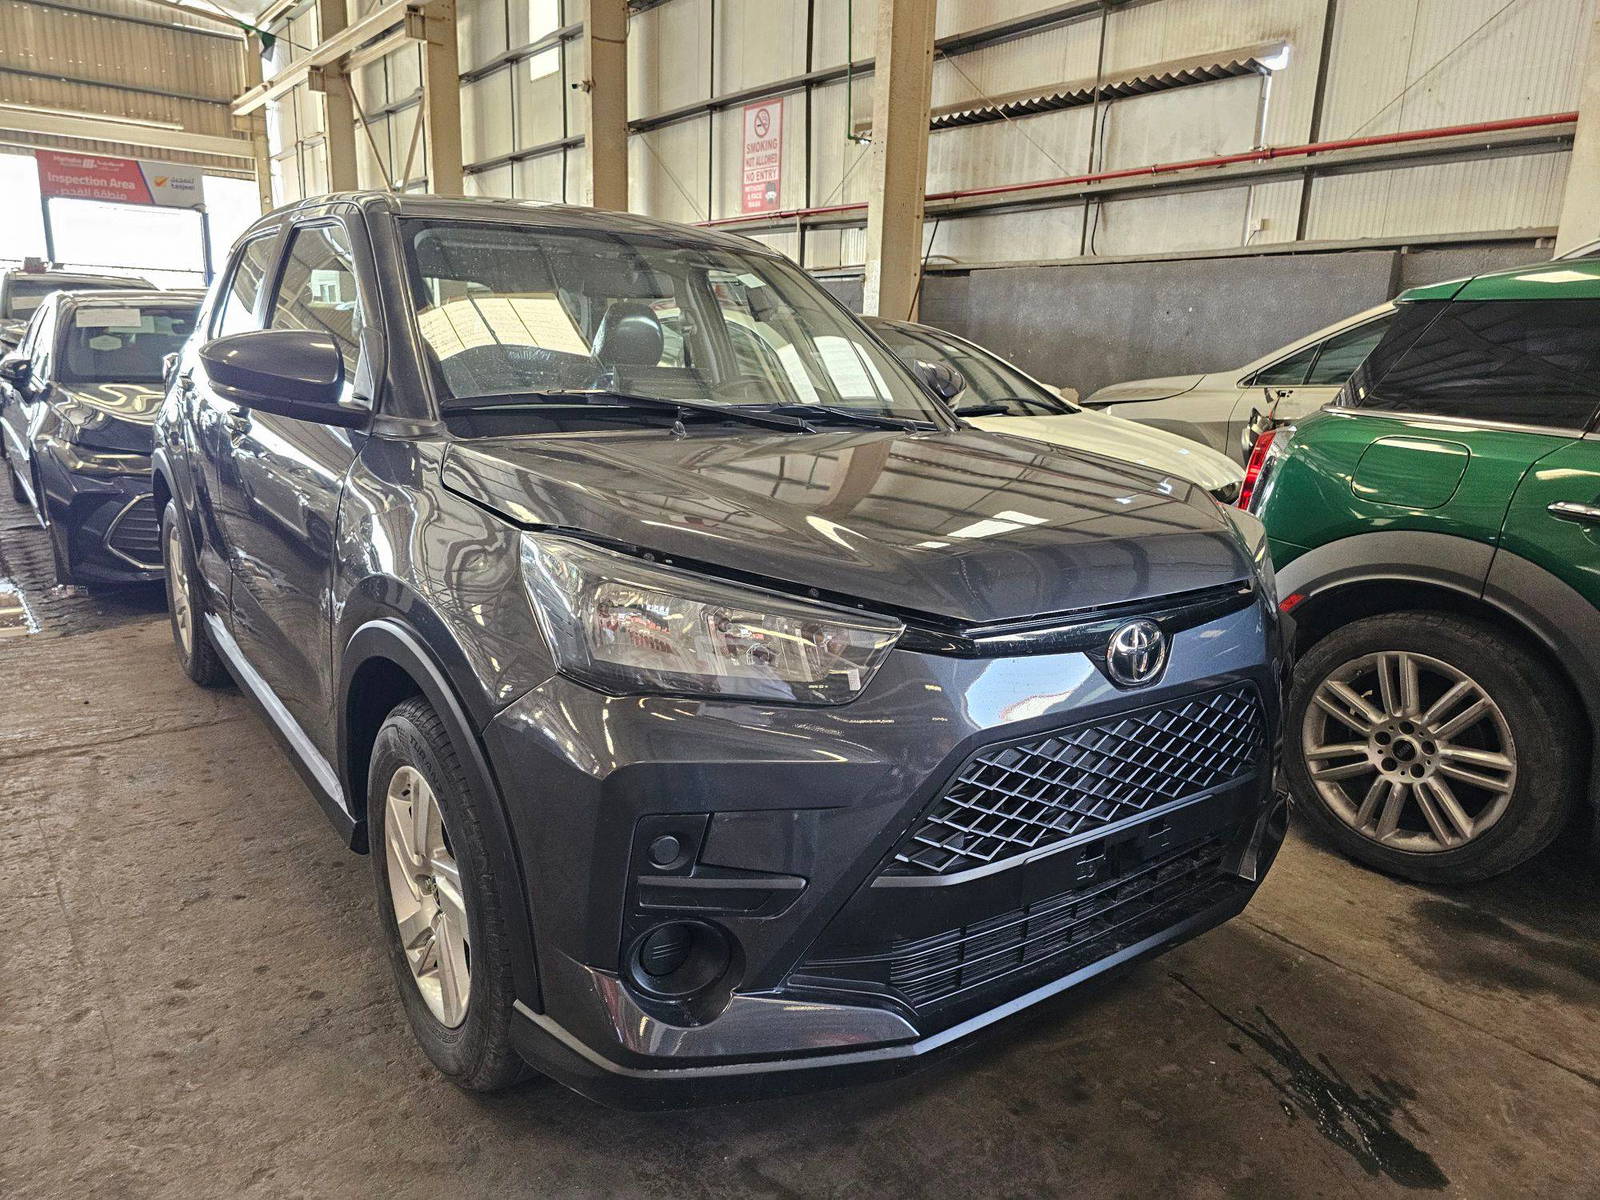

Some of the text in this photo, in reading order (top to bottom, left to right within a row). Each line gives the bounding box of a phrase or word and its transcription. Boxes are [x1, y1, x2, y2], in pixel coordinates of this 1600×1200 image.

[746, 138, 778, 154] SMOKING
[756, 153, 778, 166] ALLOWED
[48, 172, 136, 190] Inspection Area
[746, 168, 777, 182] NO ENTRY
